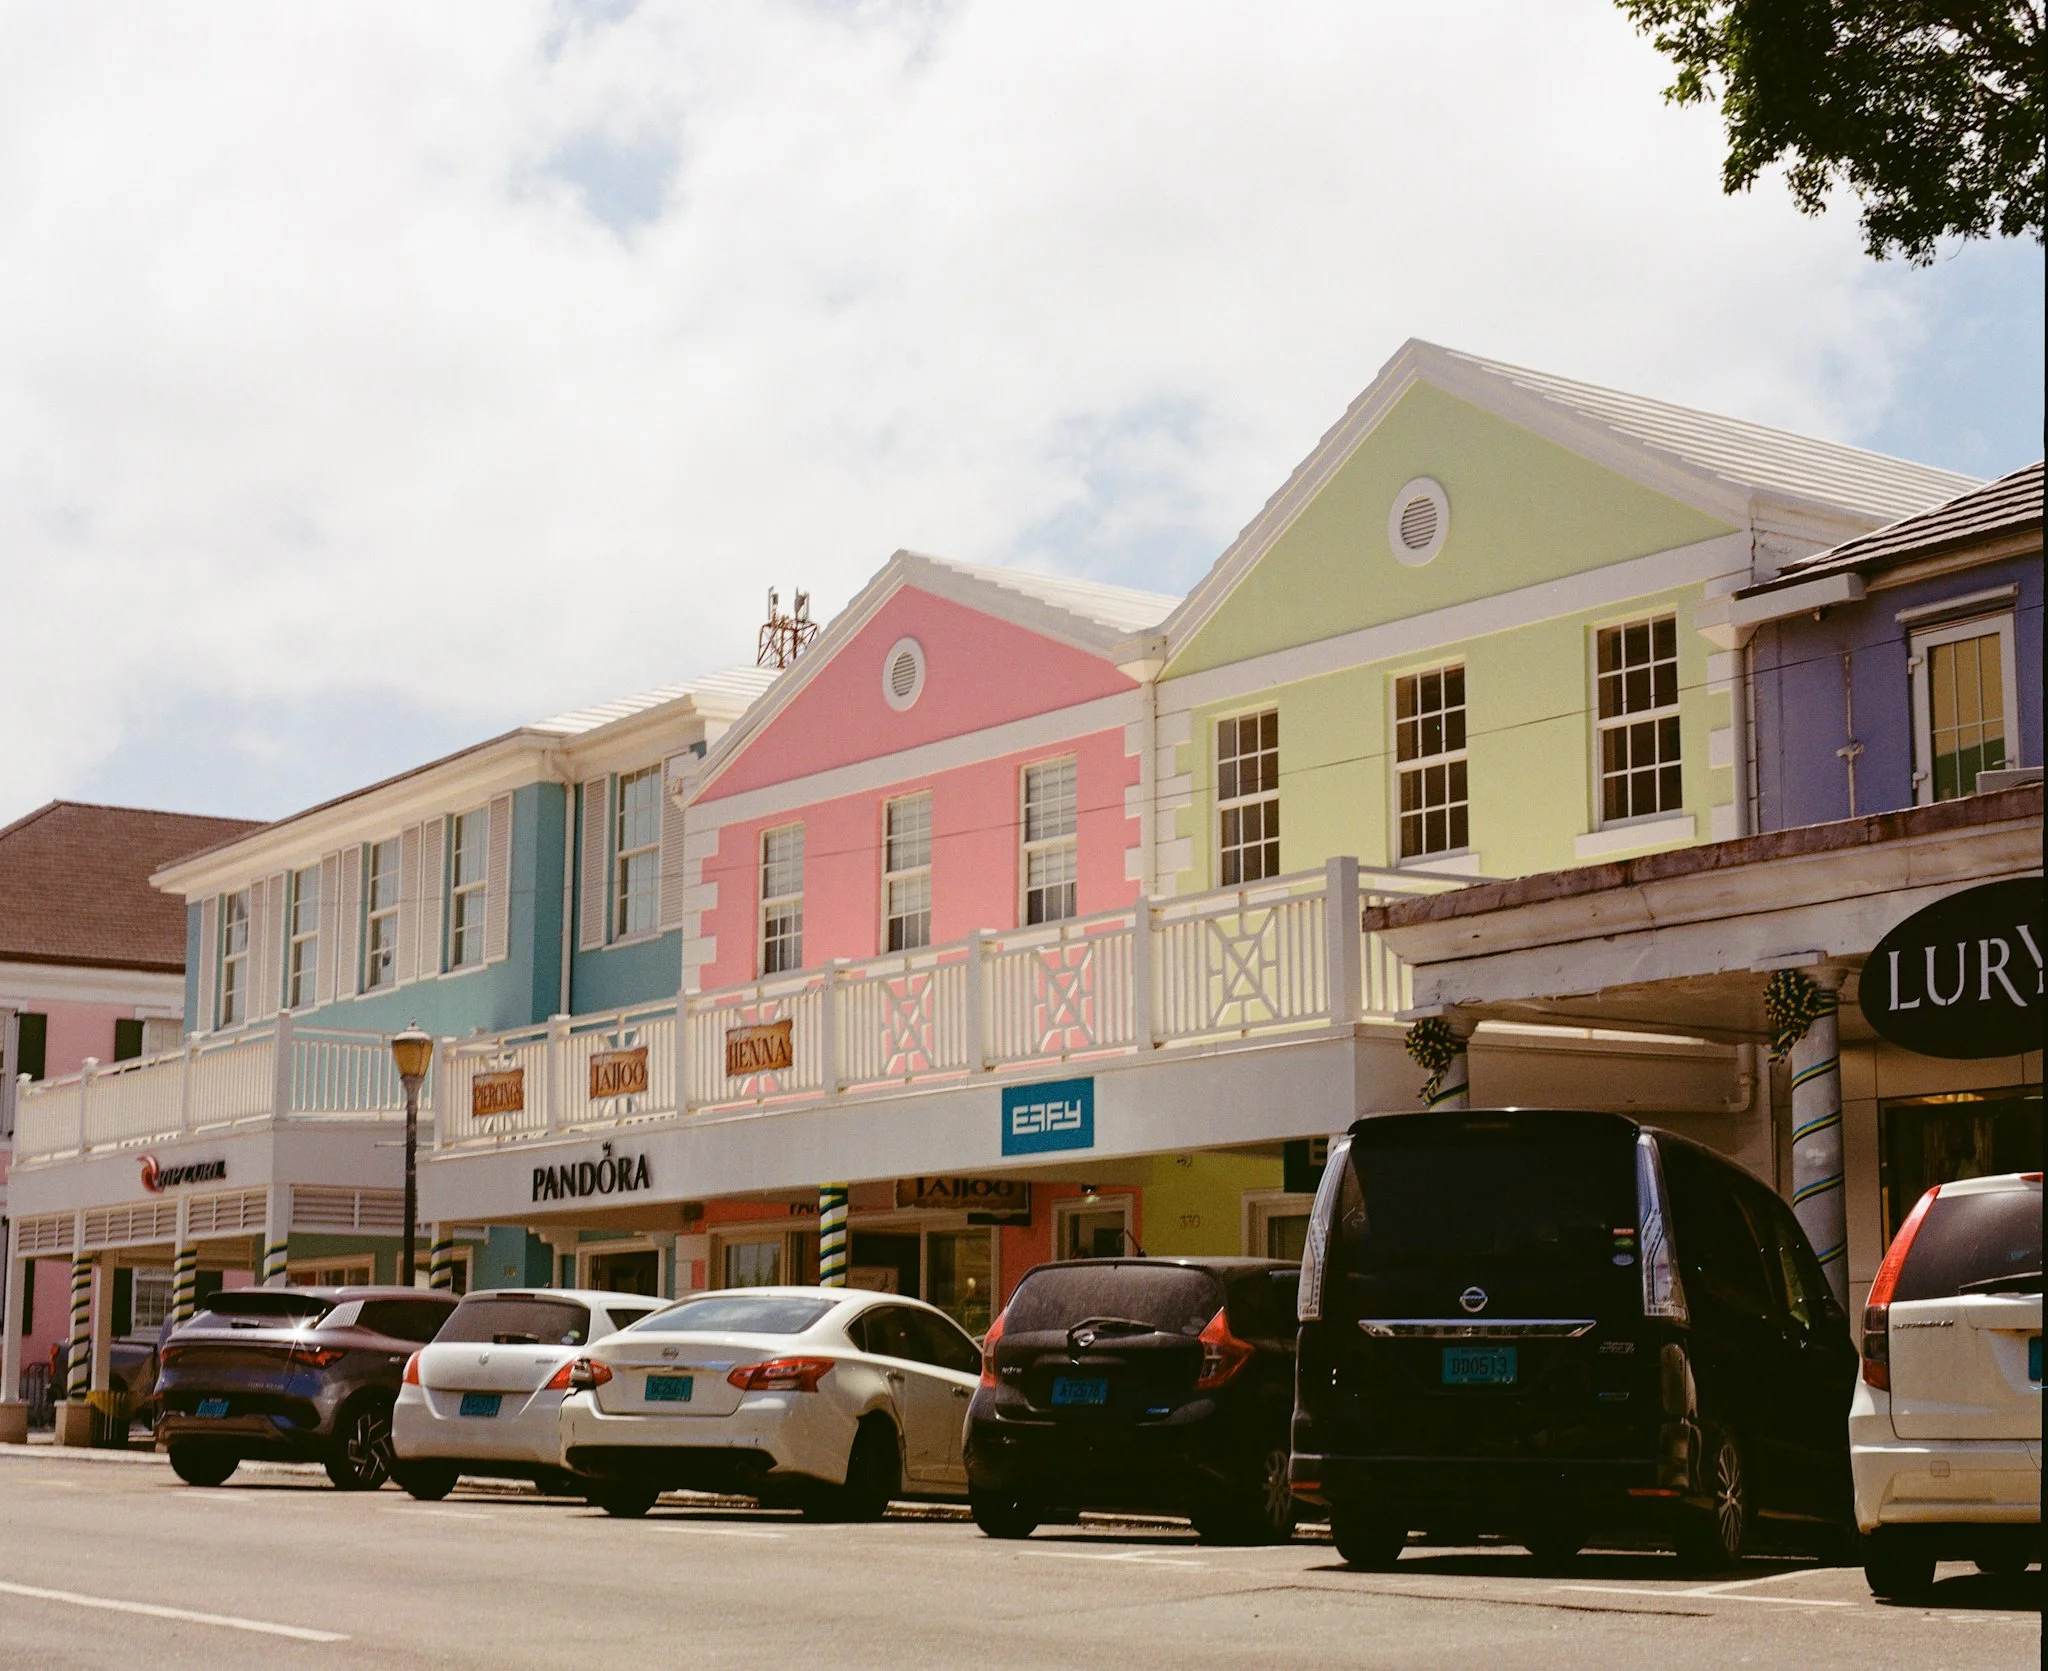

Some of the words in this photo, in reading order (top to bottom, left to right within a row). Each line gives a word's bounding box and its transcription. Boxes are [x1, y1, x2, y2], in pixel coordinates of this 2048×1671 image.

[728, 1035, 787, 1071] HENNA
[1012, 1099, 1082, 1135] EFFY
[532, 1153, 650, 1202] PANDORA
